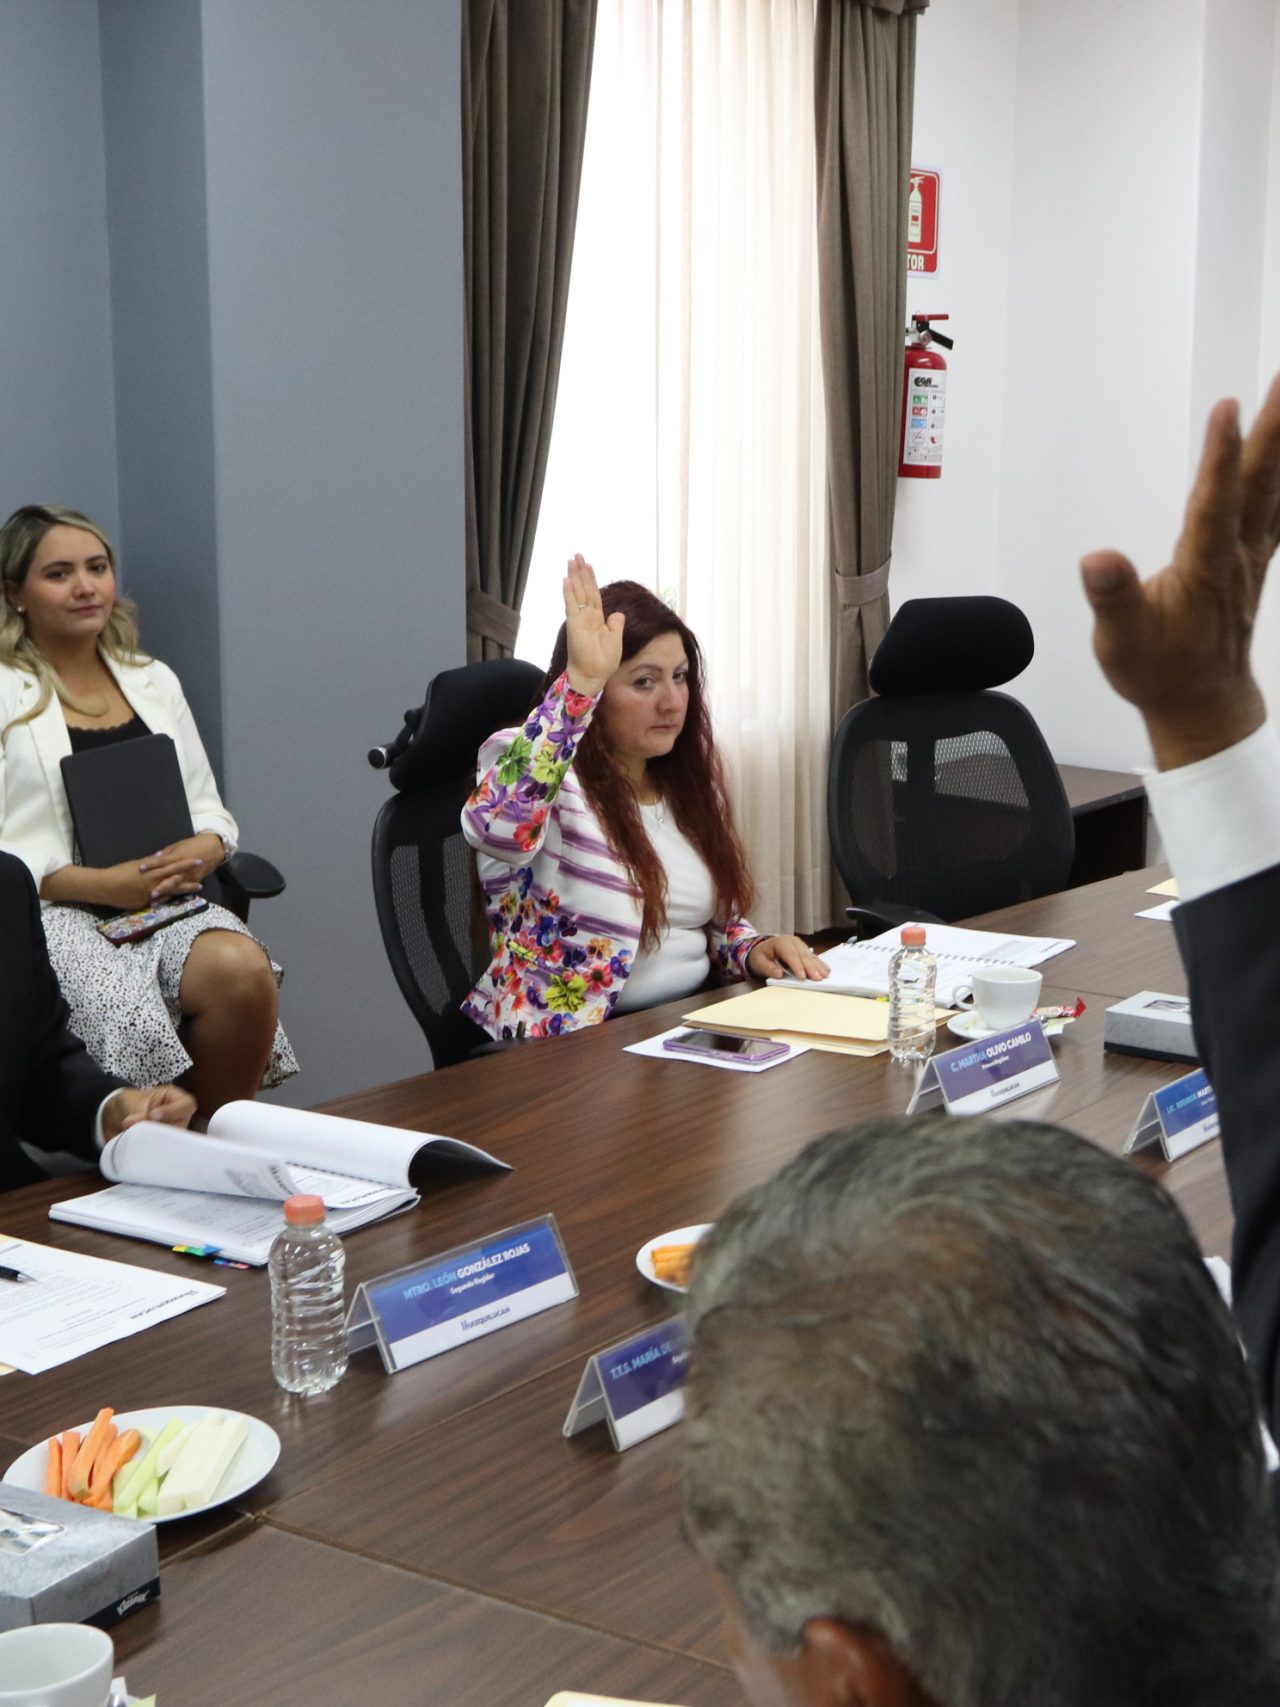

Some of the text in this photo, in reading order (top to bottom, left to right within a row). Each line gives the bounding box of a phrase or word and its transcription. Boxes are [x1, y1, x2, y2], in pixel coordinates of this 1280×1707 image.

[958, 1052, 986, 1070] MARTHA
[986, 1041, 1007, 1058] OLIVO
[1006, 1032, 1032, 1050] CAMILO
[403, 1242, 531, 1300] MTRO. LEÓN GONZÁLEZ ROJAS
[631, 1346, 661, 1370] MARÍA
